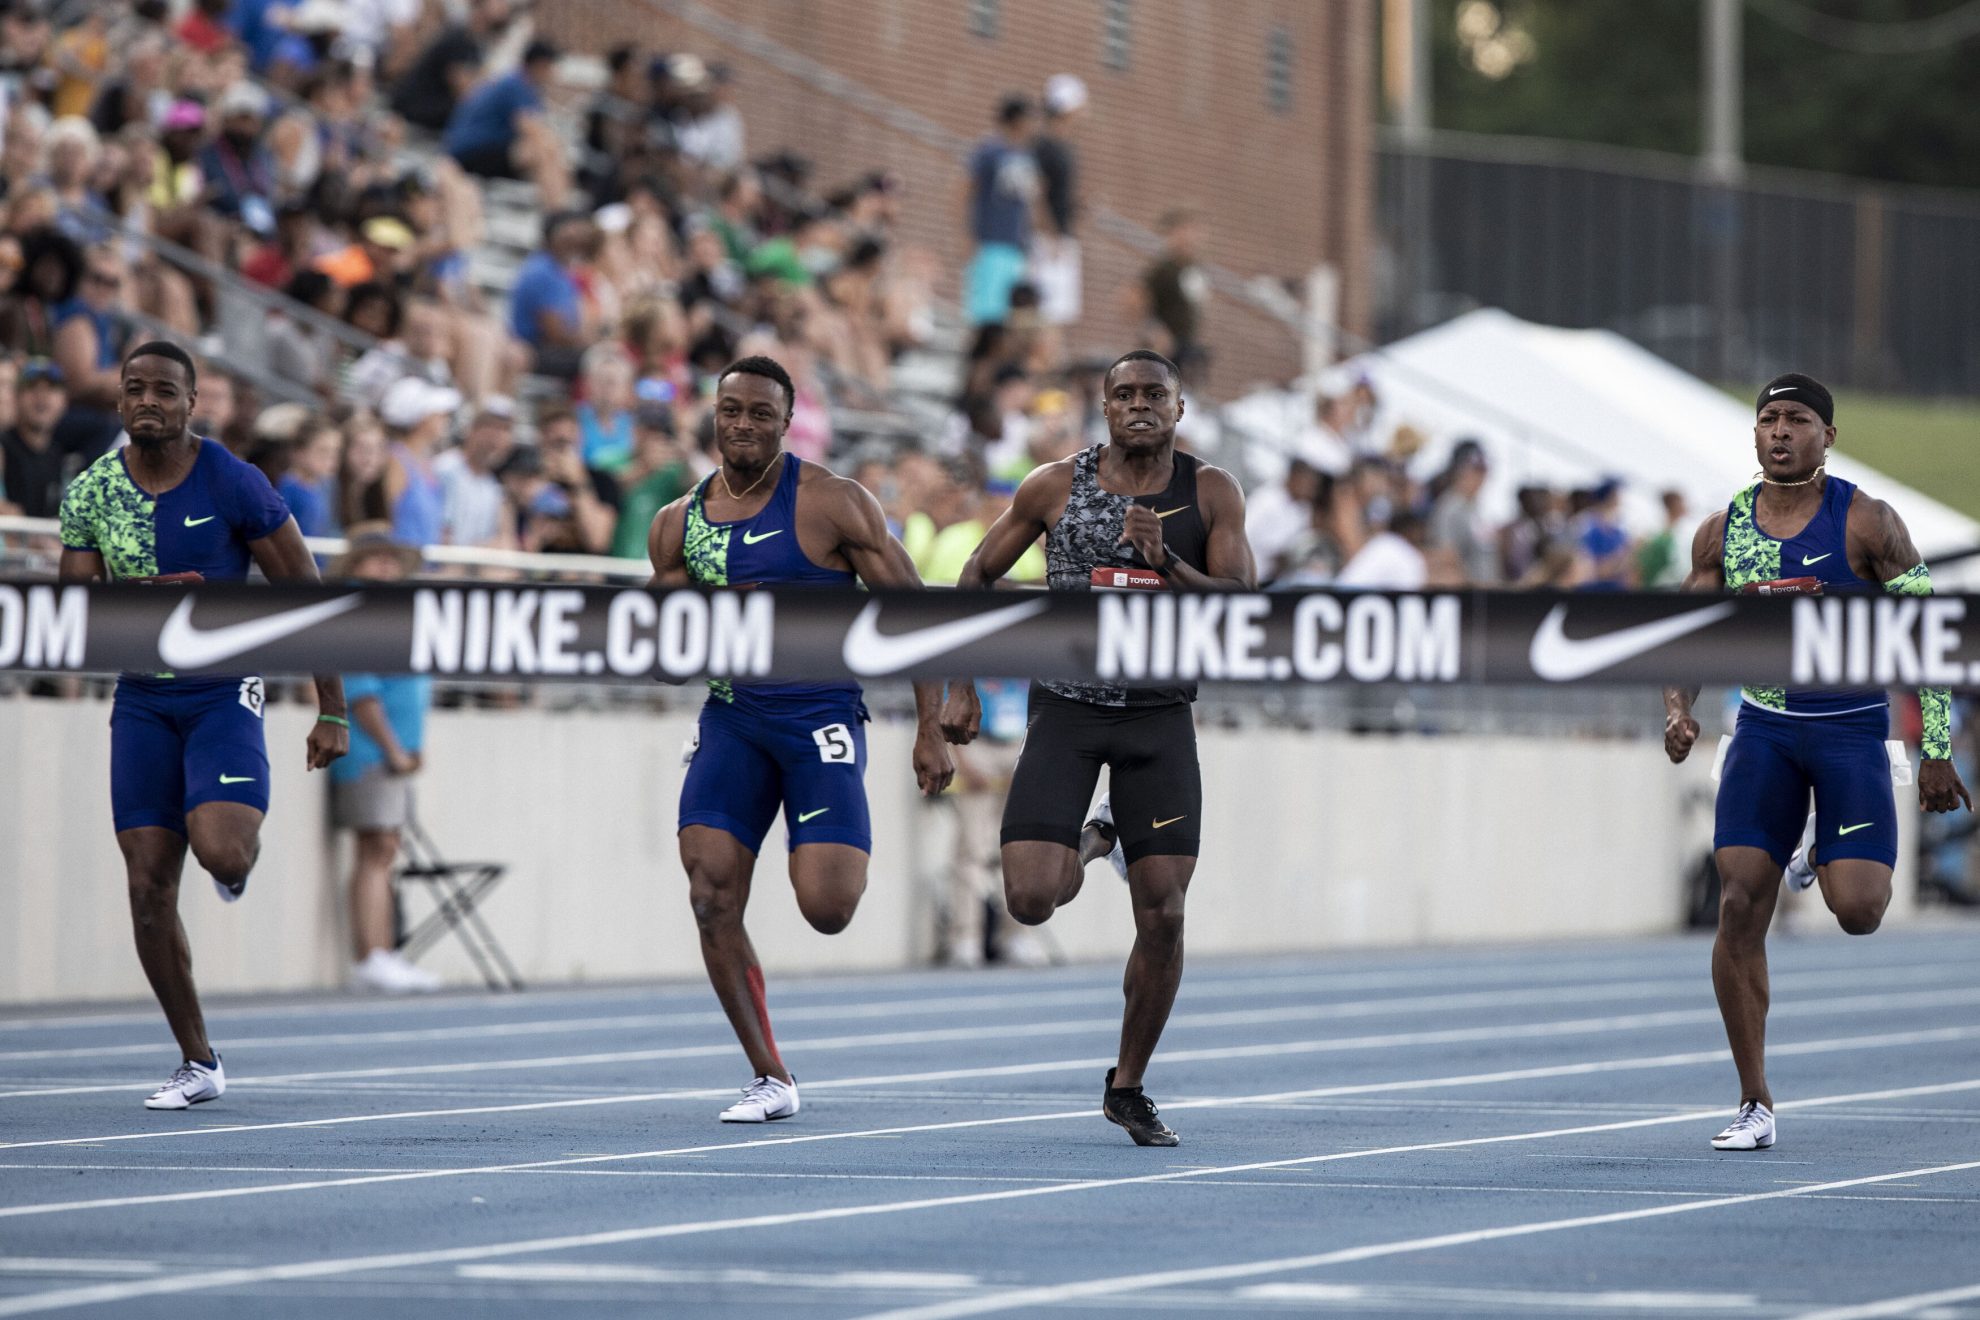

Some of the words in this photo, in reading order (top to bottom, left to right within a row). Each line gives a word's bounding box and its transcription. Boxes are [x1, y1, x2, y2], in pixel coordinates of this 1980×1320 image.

[1129, 577, 1160, 585] TOYOTA
[1772, 585, 1801, 593] TOYOTA
[410, 588, 774, 677] NIKE.COM
[1096, 592, 1461, 682] NIKE.COM
[1792, 596, 1980, 685] NIKE.
[246, 679, 261, 710] 6
[822, 726, 848, 760] 5
